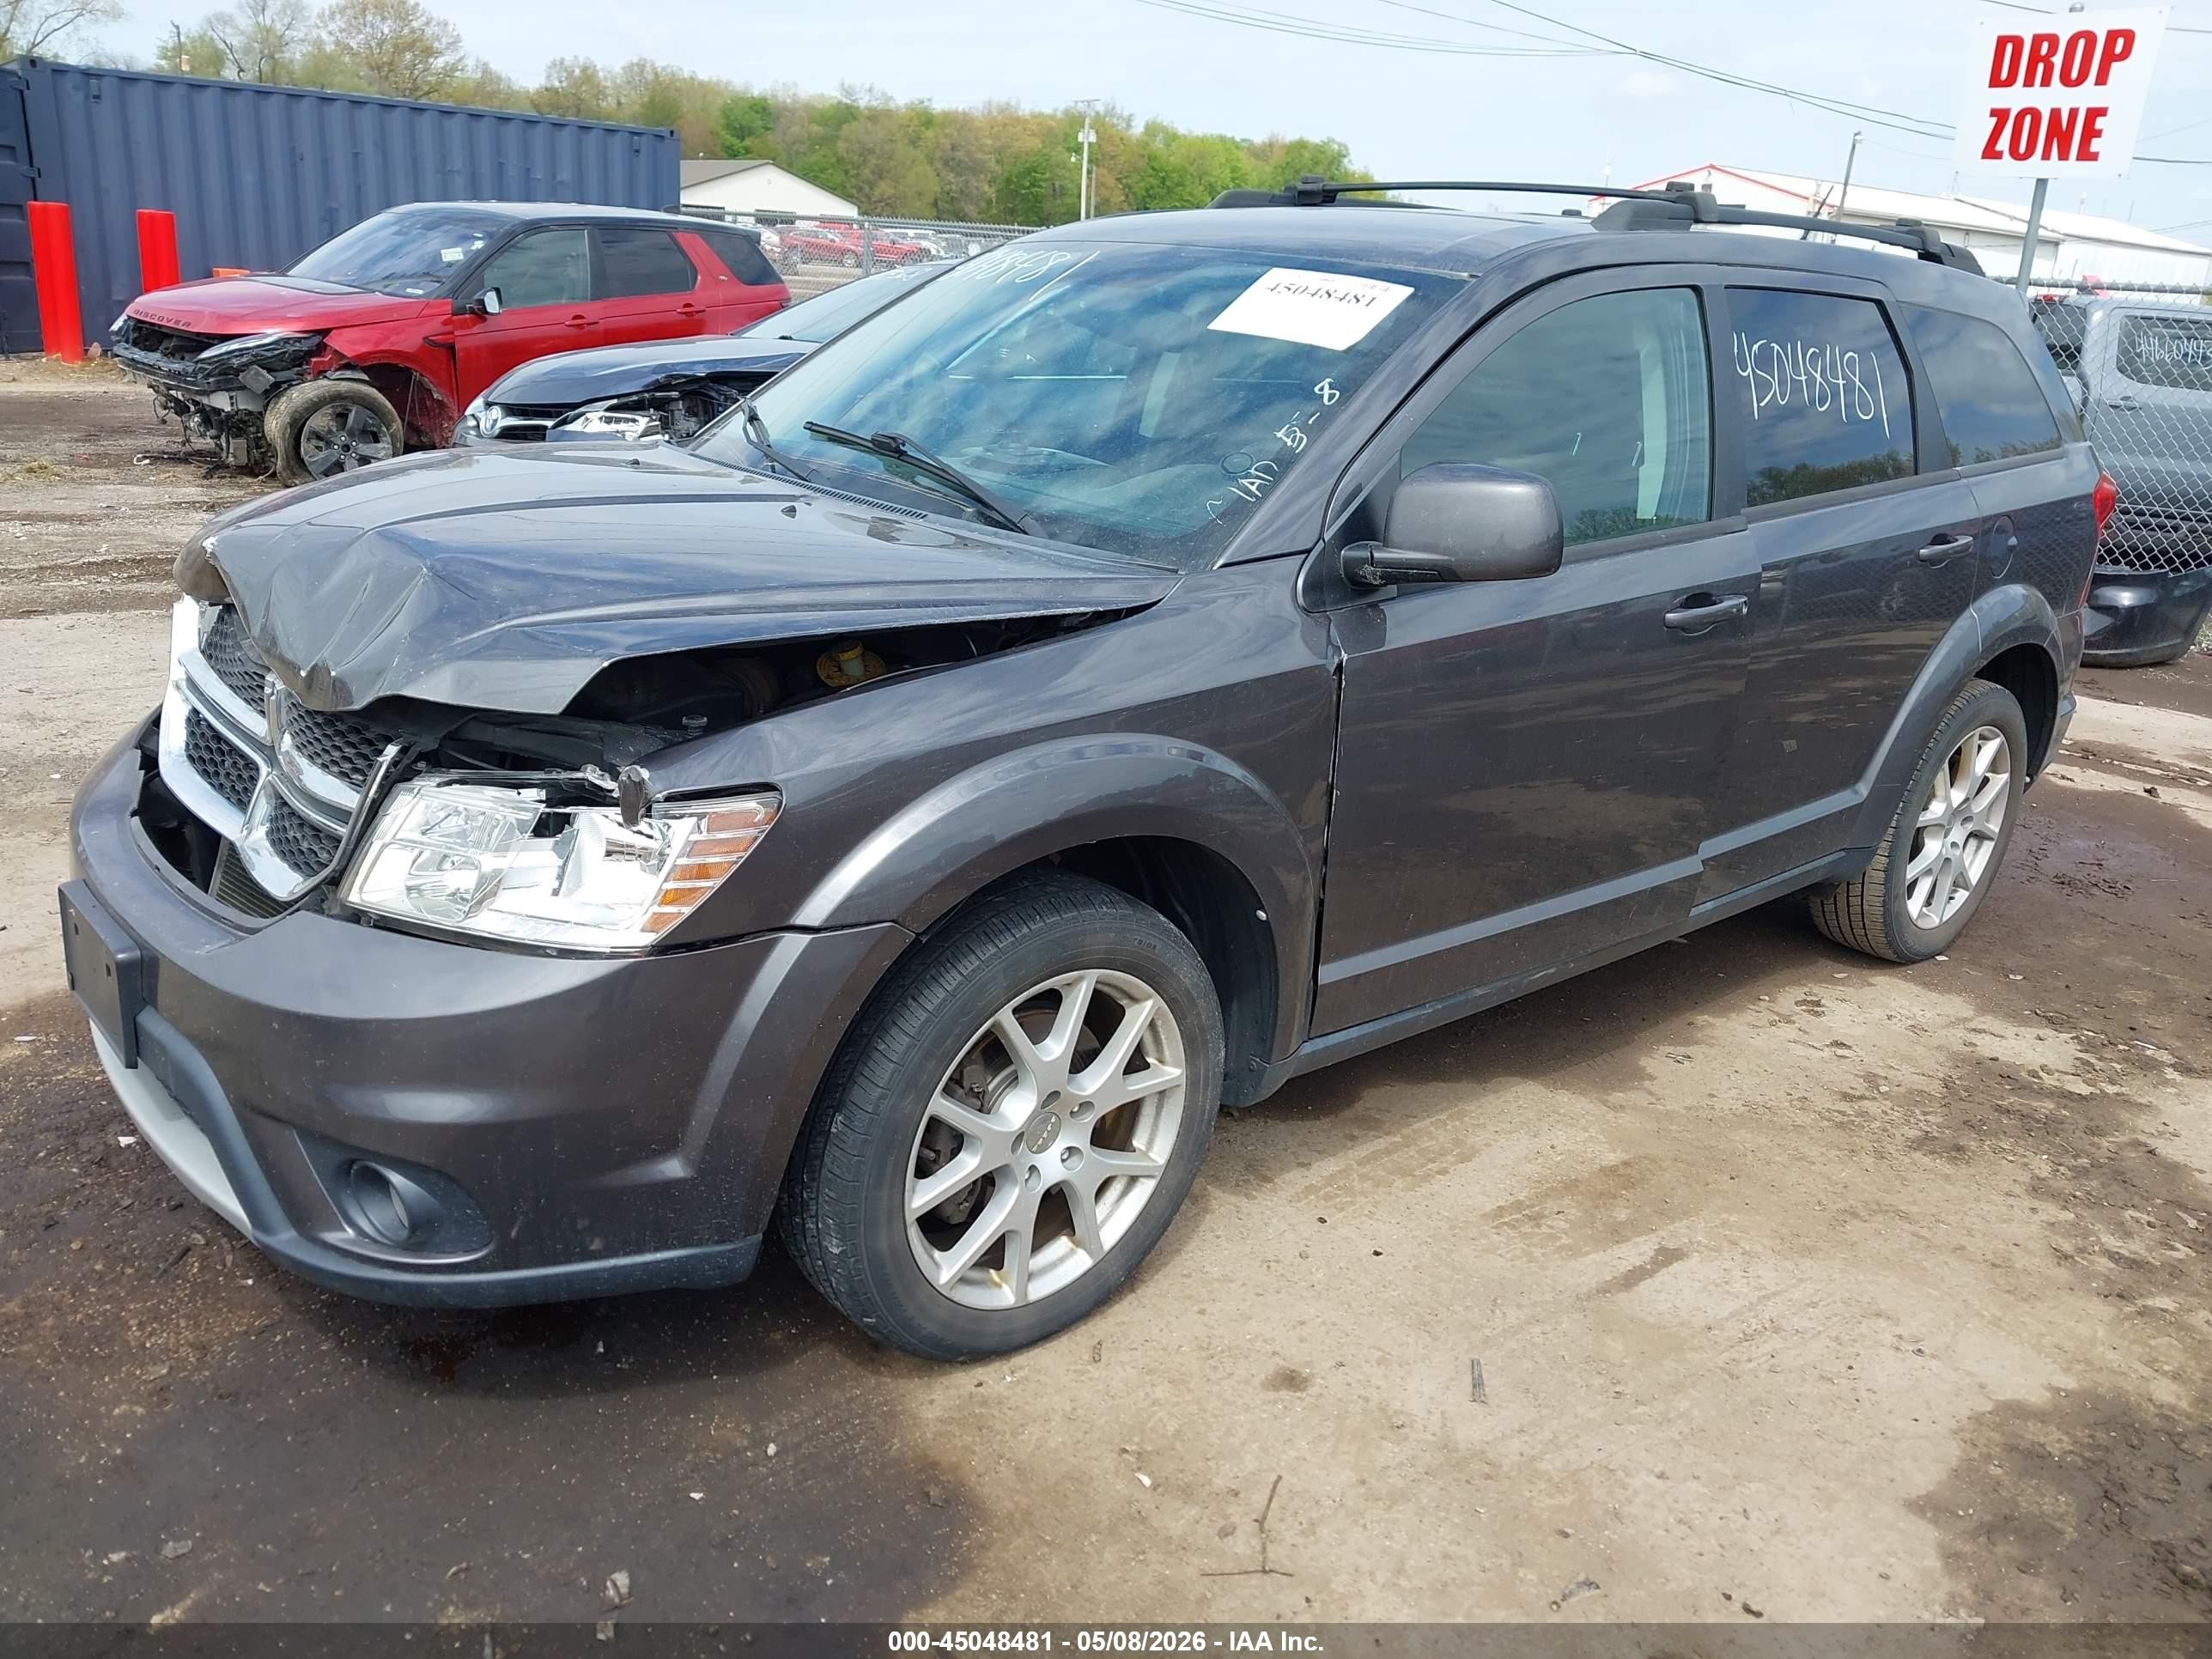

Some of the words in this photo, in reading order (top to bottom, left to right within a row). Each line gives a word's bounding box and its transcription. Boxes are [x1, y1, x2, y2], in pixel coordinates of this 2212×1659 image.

[1988, 29, 2136, 88] DROP
[1981, 106, 2109, 161] ZONE
[1265, 281, 1377, 307] 45048481
[1733, 331, 1890, 440] 45048481
